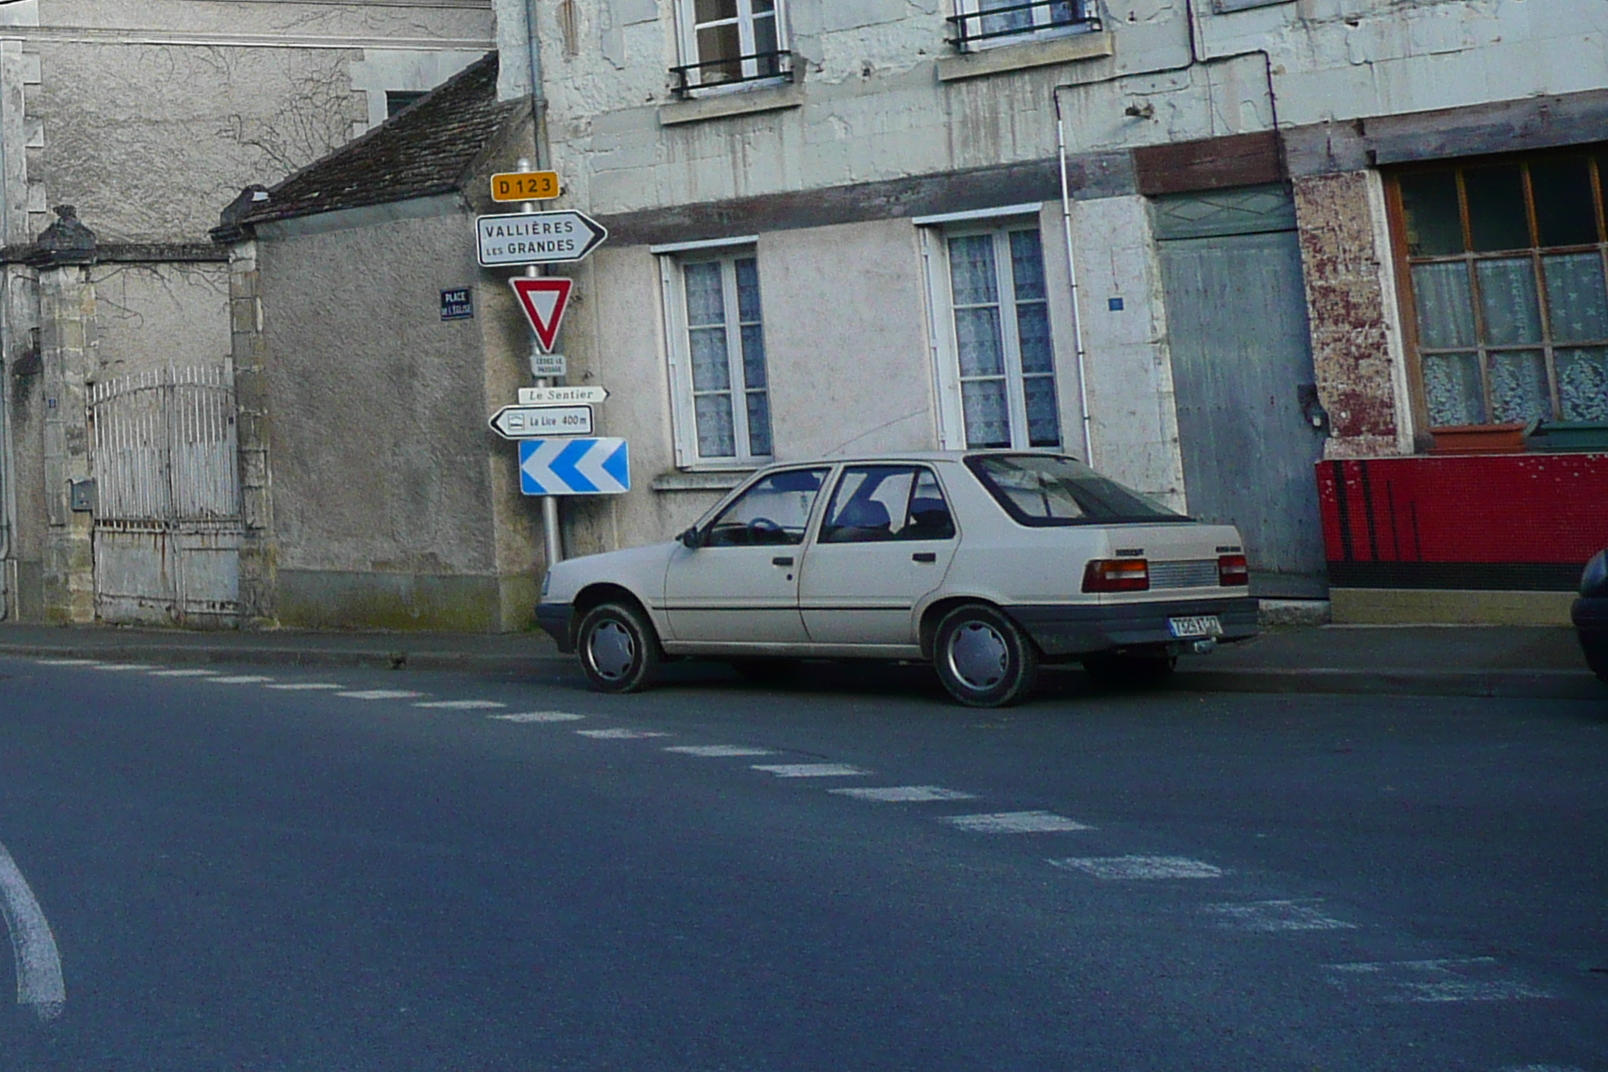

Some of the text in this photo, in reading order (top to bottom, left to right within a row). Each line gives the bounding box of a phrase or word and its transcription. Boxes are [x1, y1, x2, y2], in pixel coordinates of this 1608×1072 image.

[485, 221, 574, 238] VALLIÈRES
[486, 239, 575, 256] LES GRANDES
[530, 390, 593, 400] Le Sentier
[530, 416, 539, 427] La
